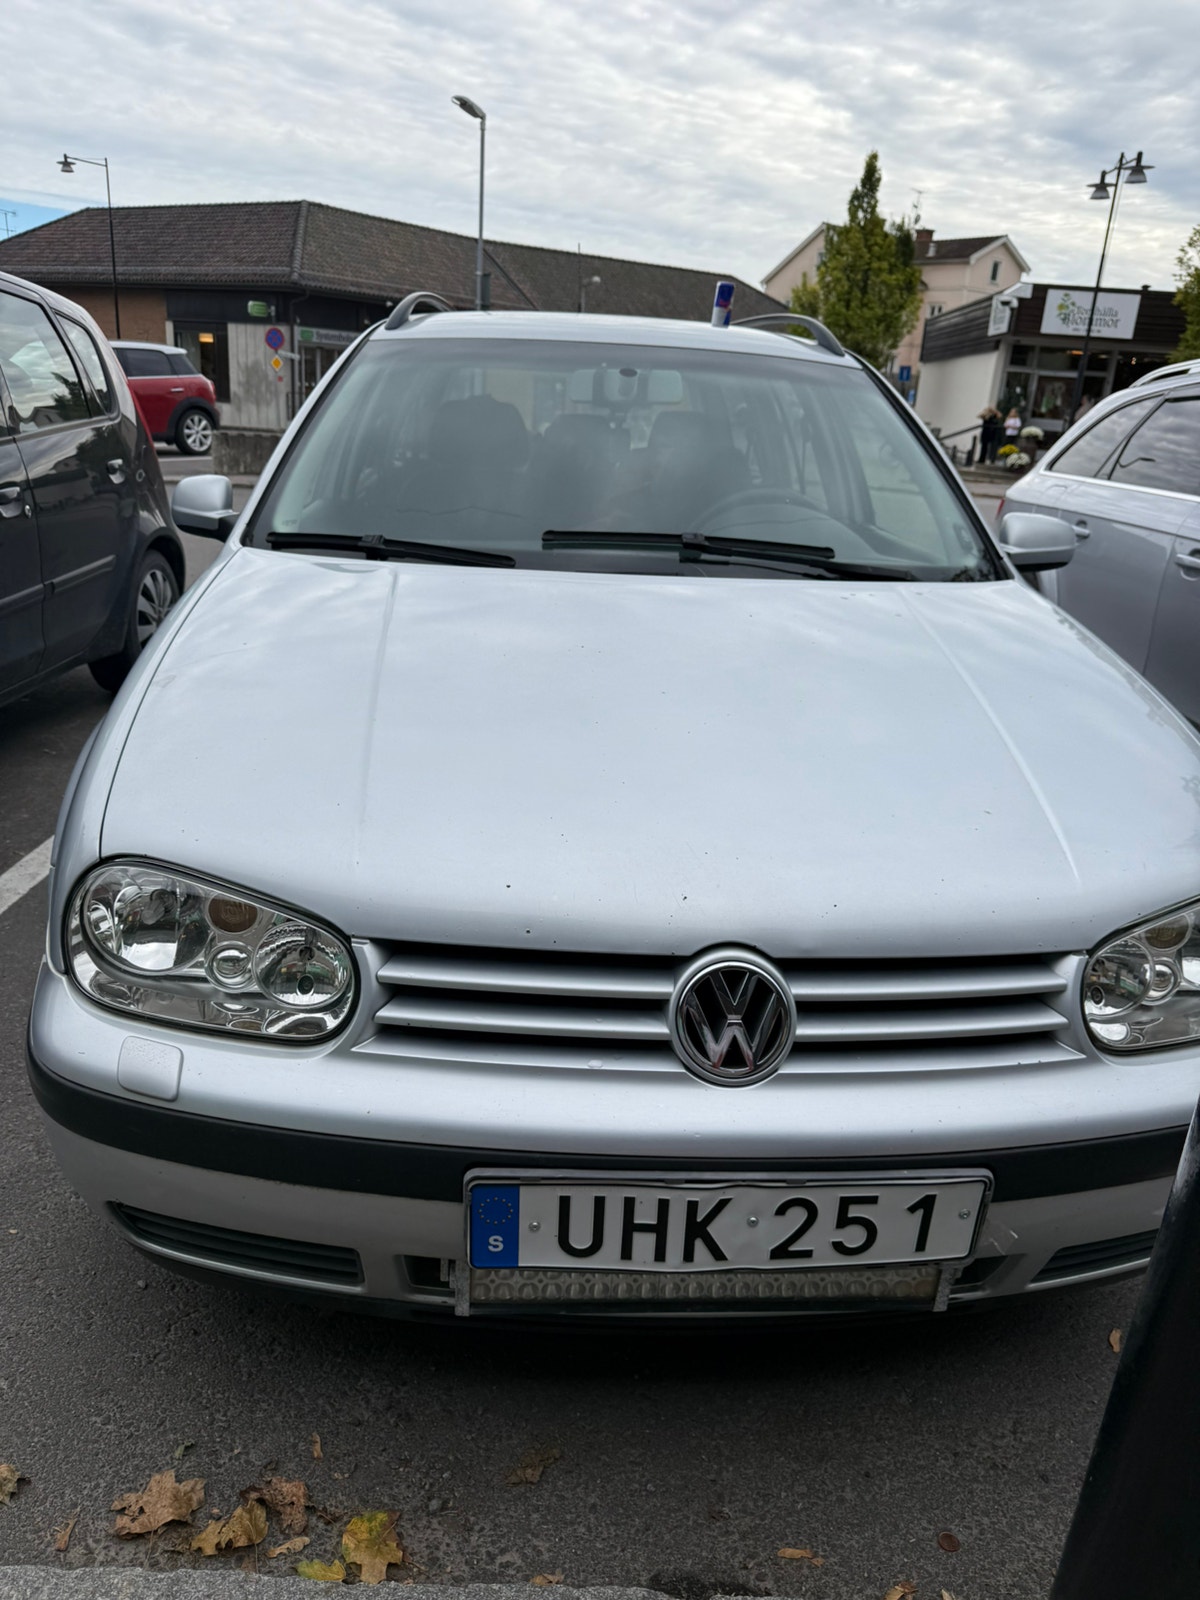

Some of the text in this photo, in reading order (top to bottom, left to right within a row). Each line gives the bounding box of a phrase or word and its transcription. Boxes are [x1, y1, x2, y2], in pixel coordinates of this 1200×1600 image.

[487, 1235, 504, 1253] S
[557, 1193, 938, 1263] UHK 251
